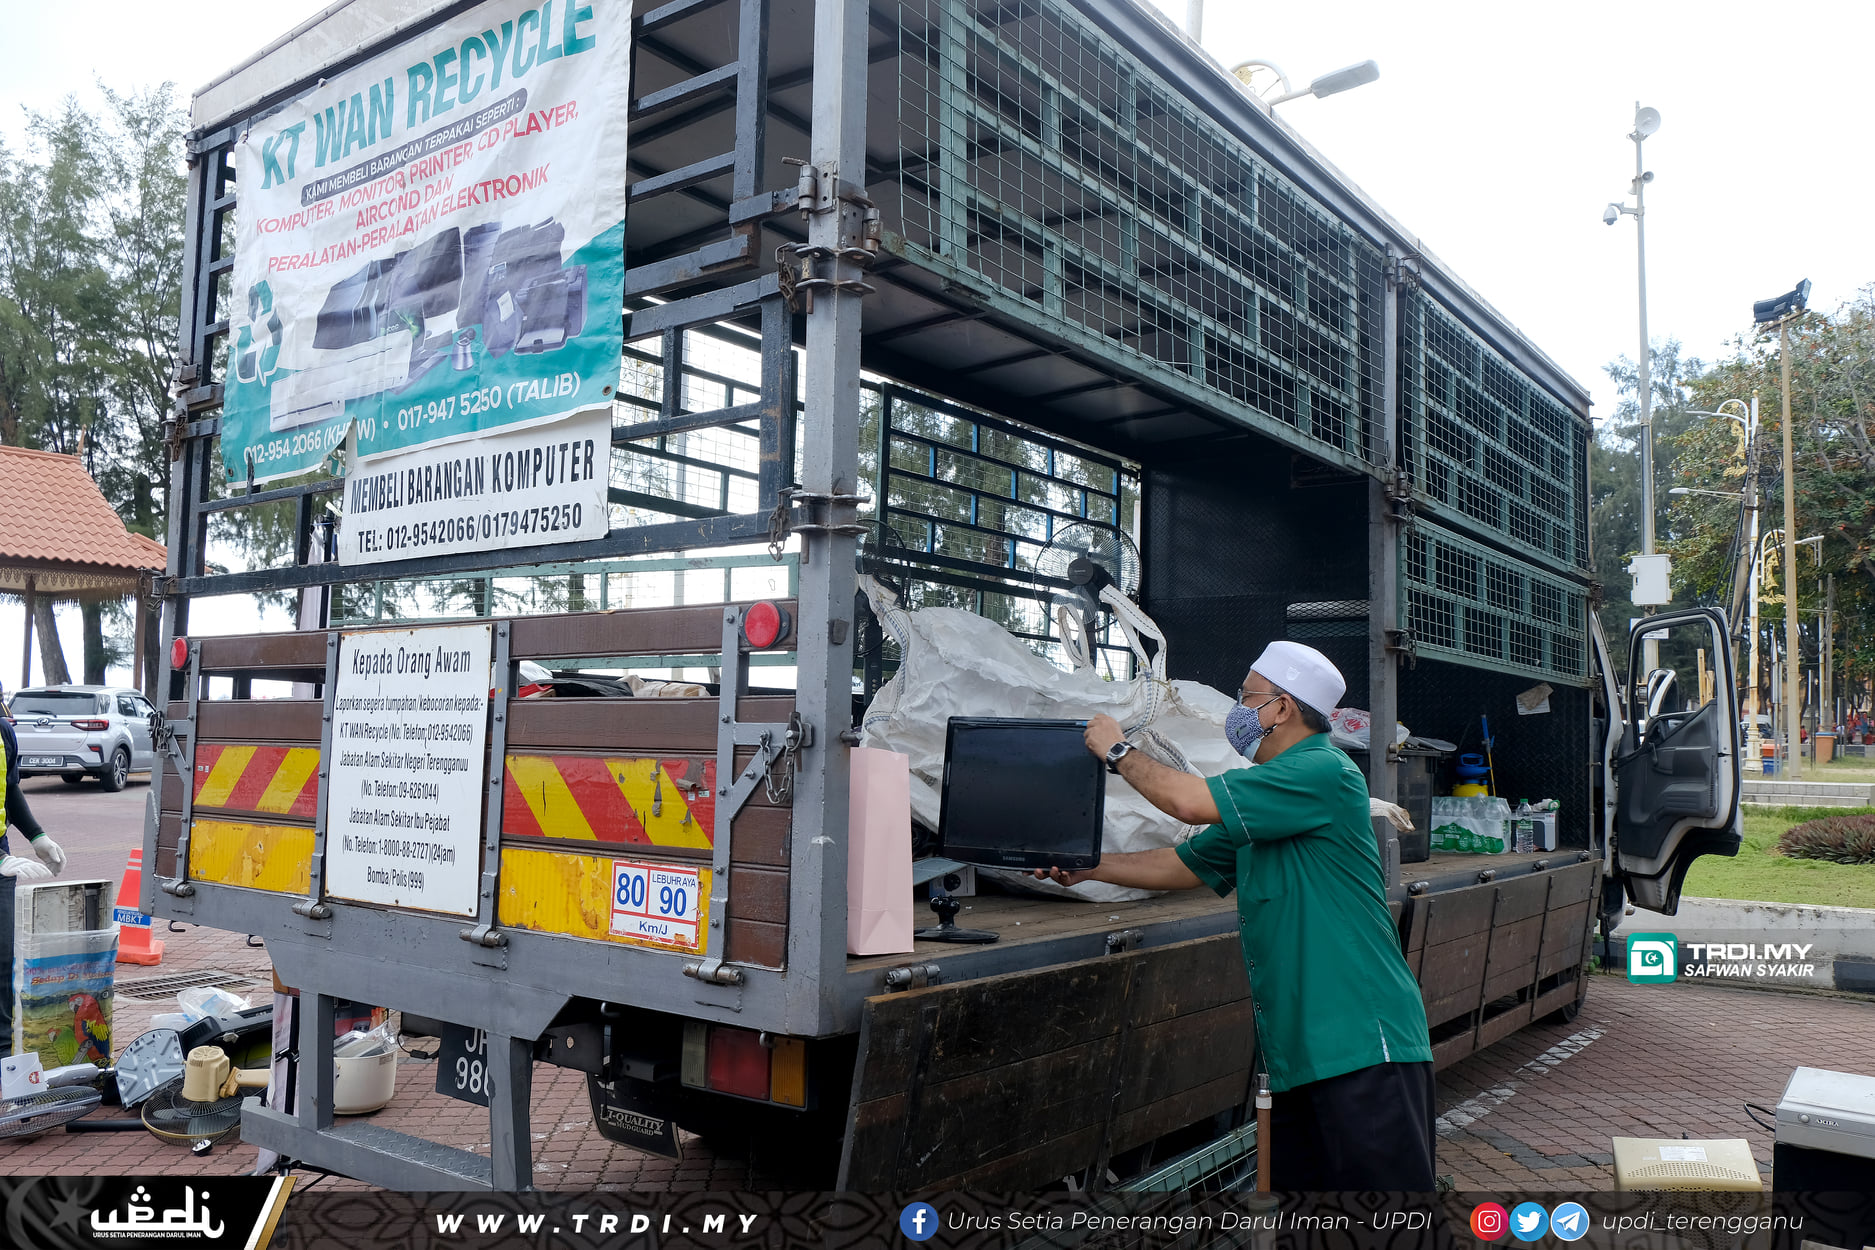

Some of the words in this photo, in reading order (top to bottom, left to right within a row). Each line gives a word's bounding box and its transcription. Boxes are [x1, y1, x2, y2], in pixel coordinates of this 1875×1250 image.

[260, 120, 306, 189] KT
[313, 77, 394, 168] WAN
[406, 0, 596, 130] RECYCLE
[257, 200, 335, 236] KOMPUTER,
[410, 142, 474, 184] PRINTER,
[478, 127, 500, 152] CD
[503, 100, 579, 142] PLAYER,
[306, 183, 328, 201] KAMI
[329, 164, 368, 191] MEMBELI
[370, 141, 423, 174] BARANGAN
[424, 119, 473, 151] TERPAKAI
[356, 189, 421, 230] AIRCOND
[424, 173, 455, 204] DAN
[269, 200, 440, 274] PERALATAN-PERALATAN
[440, 162, 551, 217] ELEKTRONIK
[243, 438, 290, 466] 012-954
[292, 430, 322, 456] 2066
[323, 417, 376, 450] (KHW)
[398, 396, 456, 431] 017-947
[460, 386, 502, 416] 5250
[506, 371, 581, 410] (TALIB)
[350, 470, 404, 515] MEMBELI
[408, 455, 484, 505] BARANGAN
[492, 439, 595, 494] KOMPUTER
[358, 529, 383, 553] TEL:
[387, 502, 582, 550] 012-9542066/0179475250
[352, 647, 392, 681] Kepada
[397, 645, 430, 679] Orang
[435, 646, 471, 673] Awam
[335, 695, 362, 714] Laporkan
[363, 698, 384, 714] segera
[340, 722, 349, 739] KT
[389, 723, 402, 743] (No.
[427, 723, 473, 745] 012-9542066)
[340, 750, 364, 767] Jabatan
[364, 751, 380, 768] Alam
[380, 751, 404, 769] Sekitar
[404, 752, 426, 773] Negeri
[361, 779, 373, 799] (No.
[374, 780, 398, 798] Telefon:
[398, 781, 439, 804] 09-6261044)
[349, 806, 373, 825] Jabatan
[373, 809, 390, 827] Alam
[390, 810, 413, 828] Sekitar
[414, 812, 424, 830] Ibu
[424, 812, 450, 834] Pejabat
[342, 834, 354, 854] (No.
[354, 836, 378, 854] Telefon:
[408, 870, 425, 892] (999)
[617, 873, 645, 907] 80
[652, 873, 696, 888] LEBUHRAYA
[660, 886, 687, 917] 90
[117, 914, 143, 924] MBKT
[639, 920, 668, 935] Km/J
